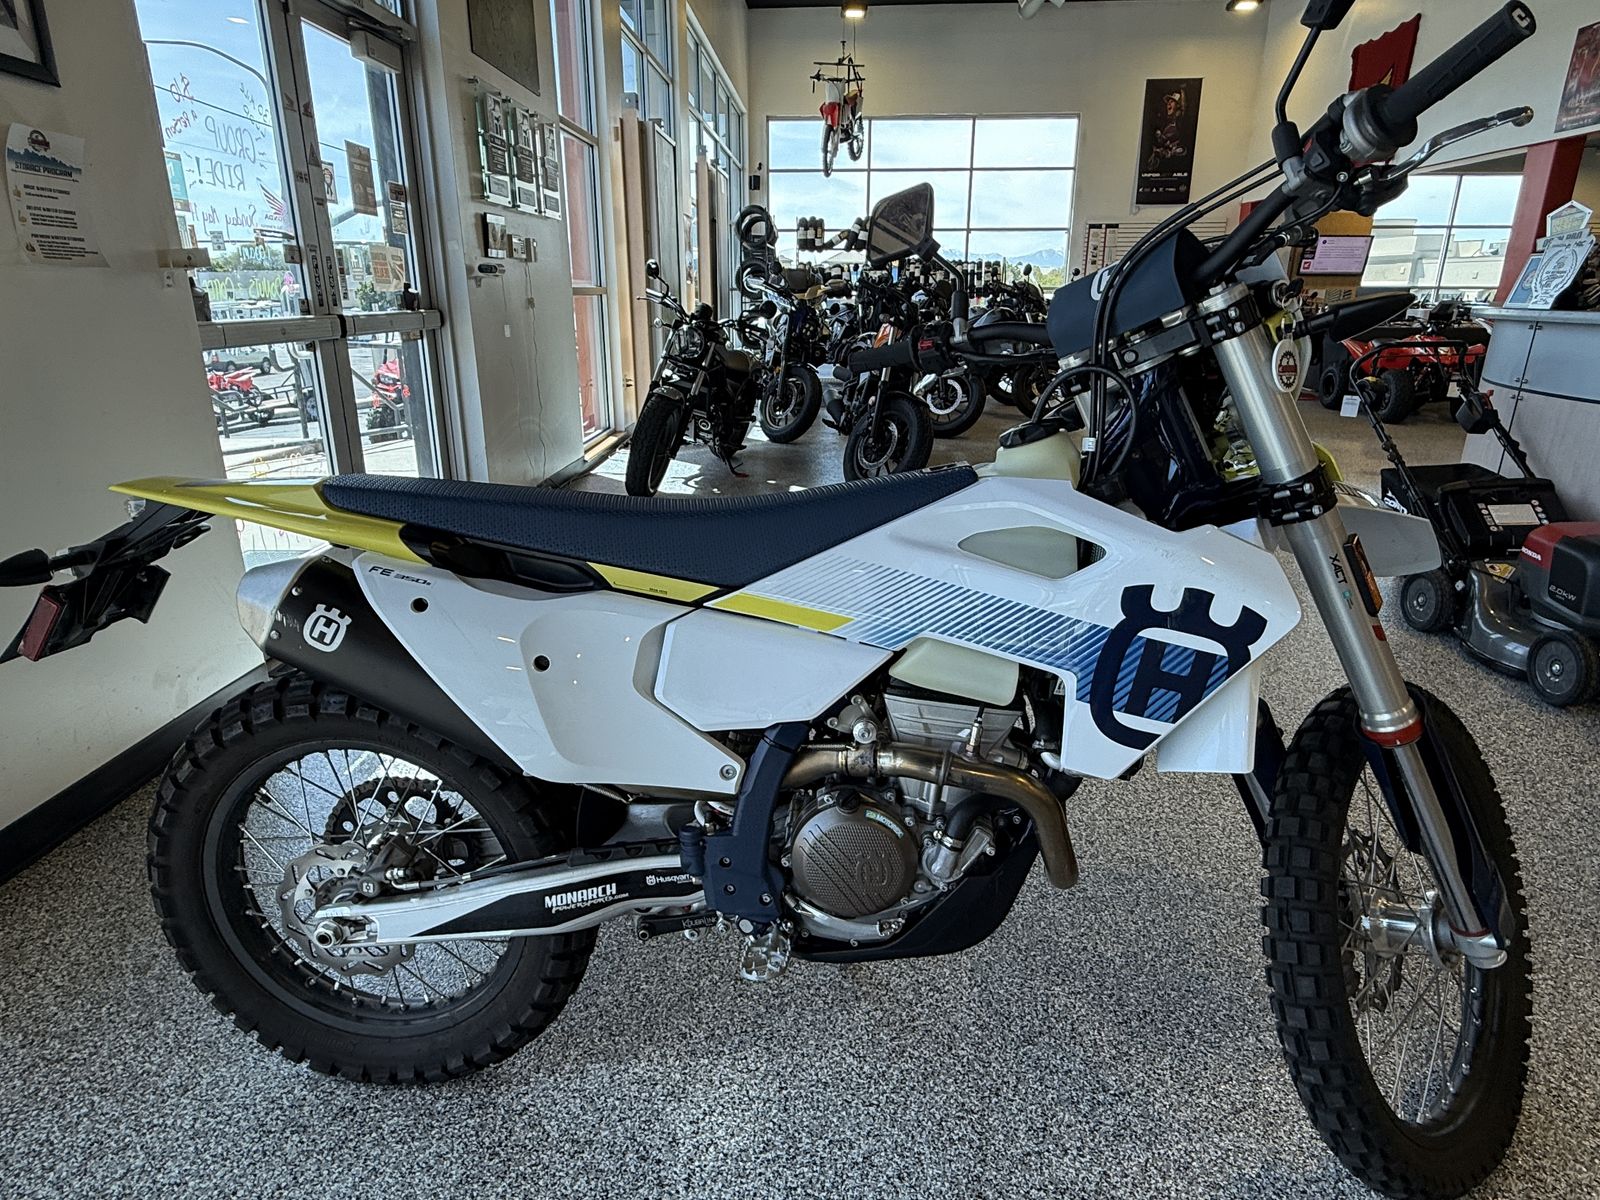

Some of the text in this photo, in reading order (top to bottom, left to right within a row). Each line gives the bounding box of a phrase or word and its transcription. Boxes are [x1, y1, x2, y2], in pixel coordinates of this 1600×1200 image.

[43, 166, 73, 178] PROGRAM
[368, 565, 395, 577] FE
[1329, 553, 1348, 584] XACT
[544, 882, 617, 909] MONARCH
